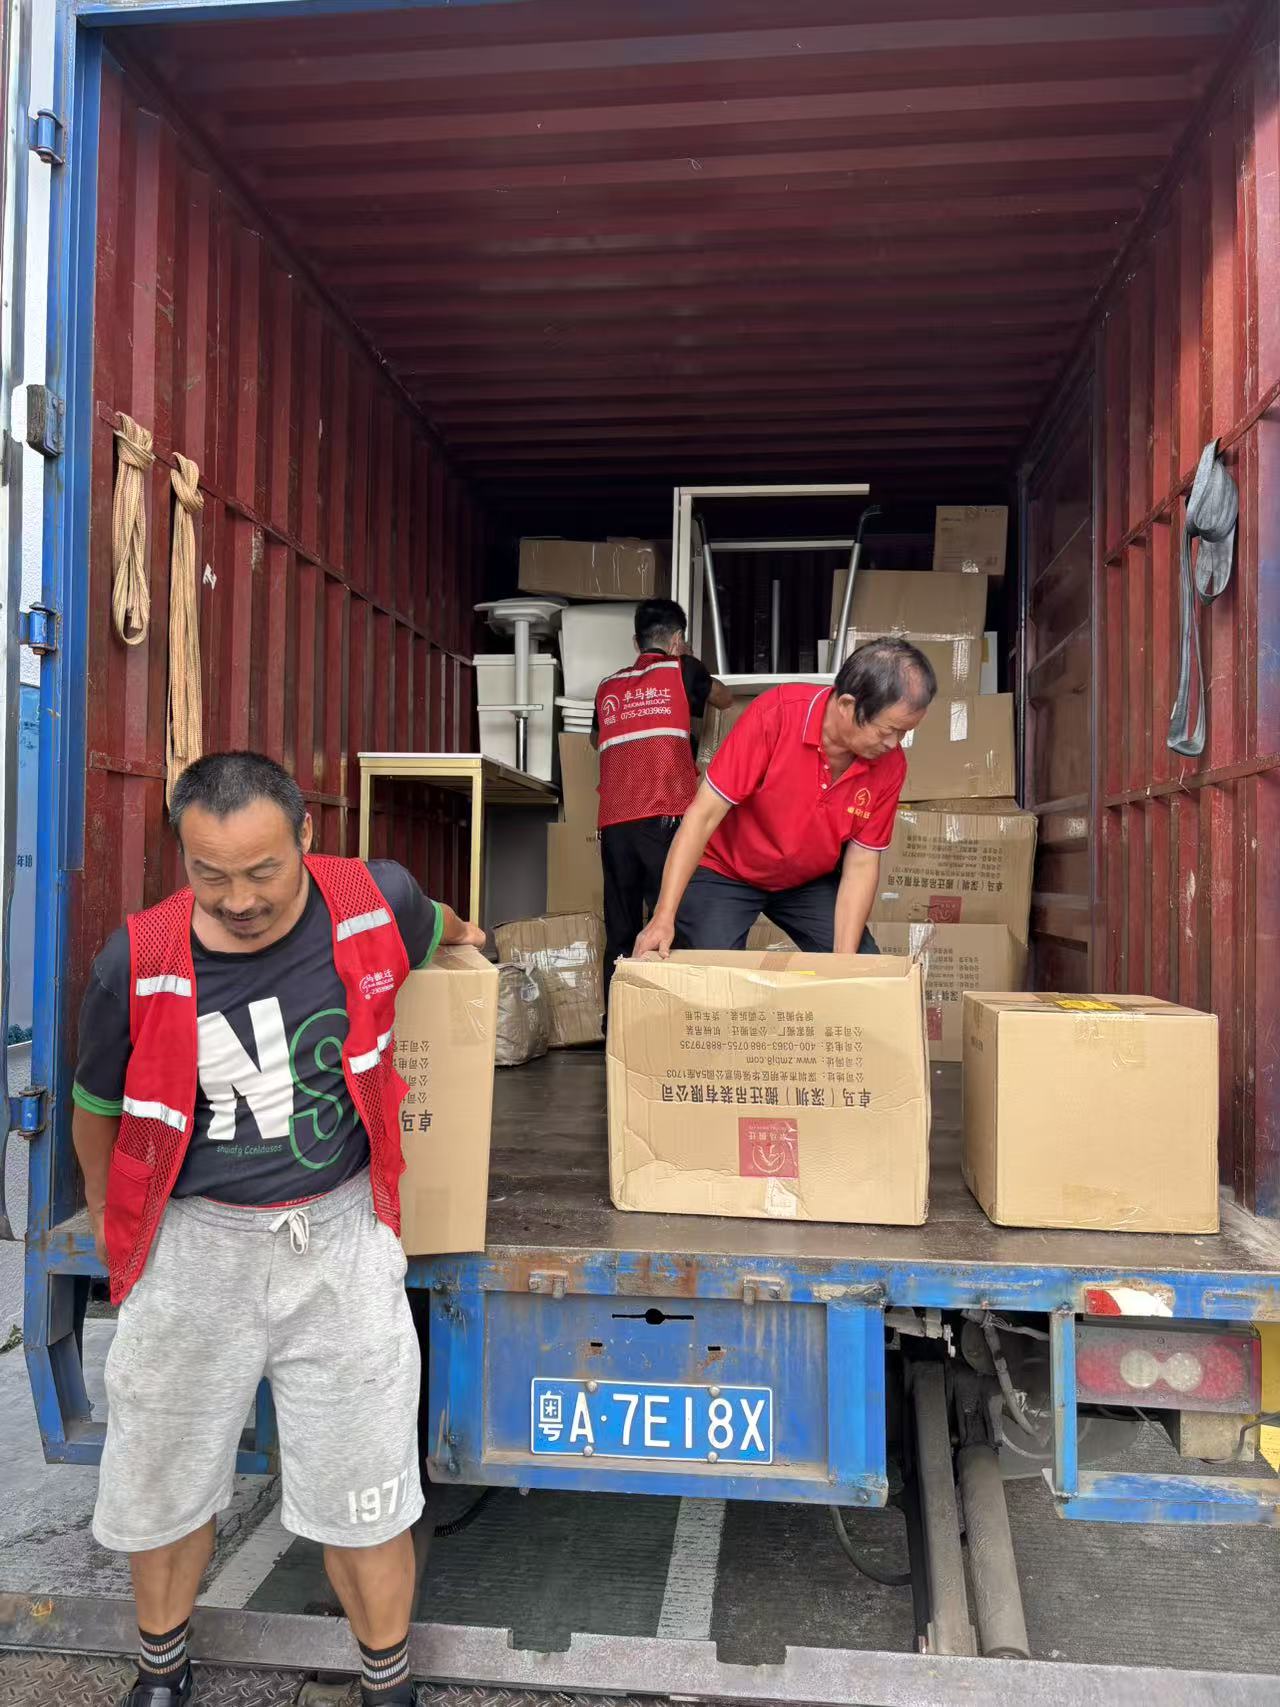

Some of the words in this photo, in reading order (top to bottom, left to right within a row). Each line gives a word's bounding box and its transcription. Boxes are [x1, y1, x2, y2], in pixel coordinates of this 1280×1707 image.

[622, 687, 672, 703] 卓马搬迁
[620, 707, 672, 720] 0755-23039696
[661, 1083, 872, 1107] 卓马（深圳）搬迁吊装有限公司
[401, 1109, 433, 1133] 卓马
